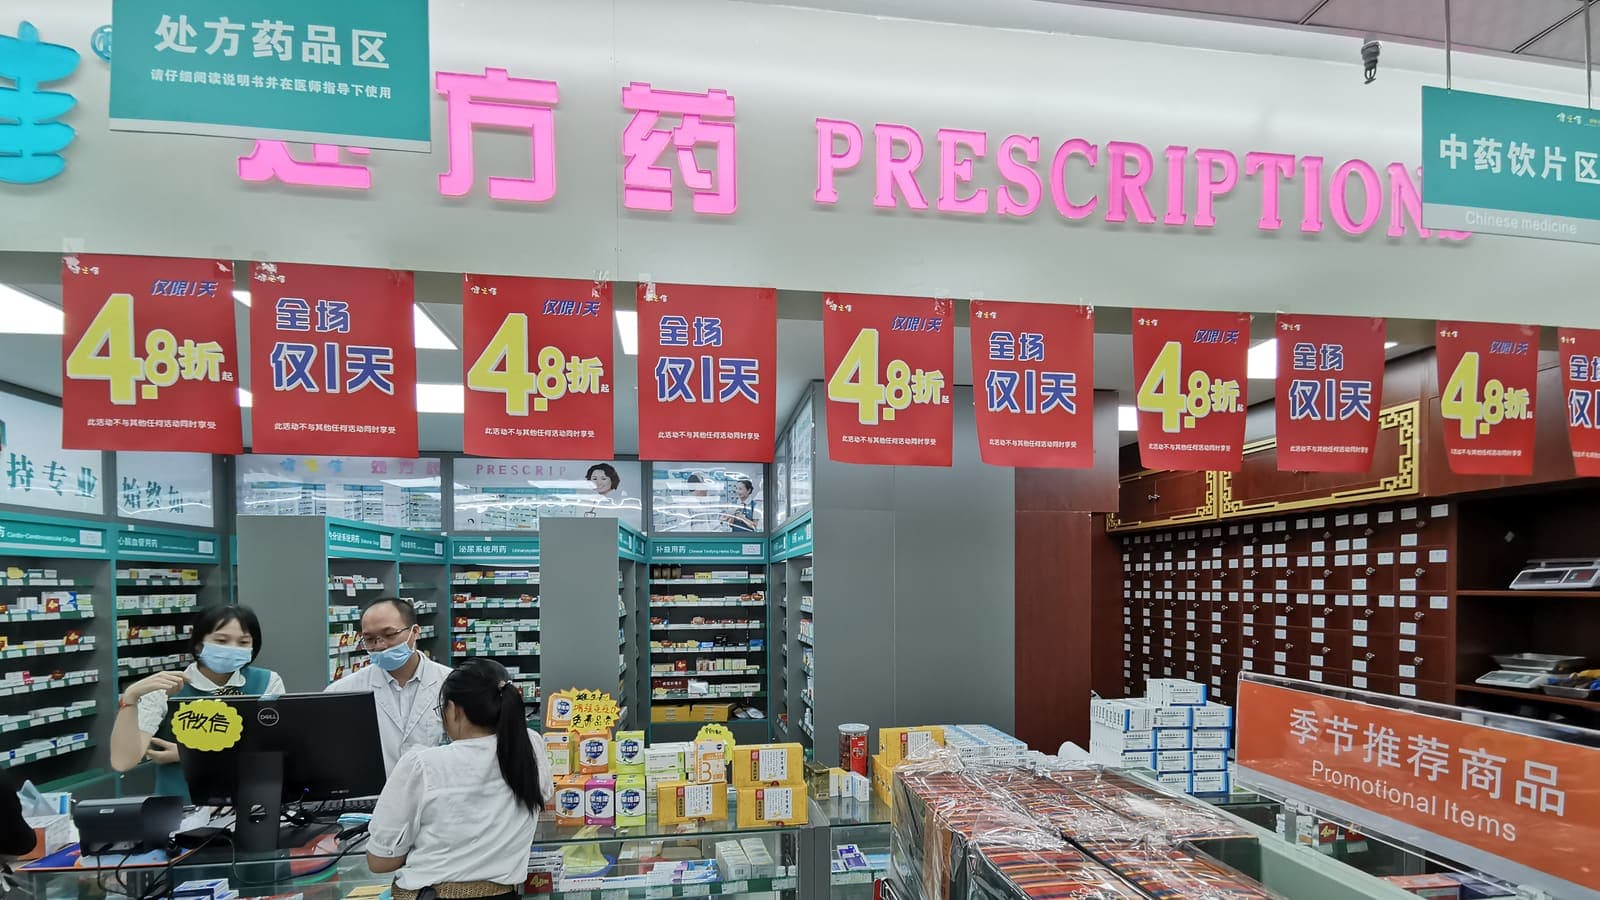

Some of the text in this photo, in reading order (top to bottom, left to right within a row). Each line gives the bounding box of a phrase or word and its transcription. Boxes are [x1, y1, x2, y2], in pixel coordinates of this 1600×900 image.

[154, 14, 390, 69] 处方药品区
[150, 69, 392, 100] 请仔细阅读说明书并在医师指导下使用
[237, 67, 737, 215] 方药
[813, 117, 1472, 241] PRESCRIPTION
[1439, 133, 1600, 185] 中药饮片区
[1465, 210, 1577, 235] Chinese medicine
[151, 279, 219, 298] 仅限1天
[276, 297, 350, 334] 全场
[541, 299, 601, 317] 仅限1天
[891, 315, 943, 333] 仅限1天
[660, 315, 723, 347] 全场
[988, 331, 1045, 362] 全场
[270, 341, 395, 395] 仅1天
[1293, 342, 1344, 372] 全场
[655, 355, 760, 405] 仅1天
[985, 369, 1077, 415] 仅1天
[1288, 378, 1372, 422] 仅1天
[476, 463, 567, 477] PRESCRIP
[655, 545, 687, 554] 补益用药
[177, 709, 231, 735] 微信
[1289, 708, 1566, 817] 季节推荐商品
[1311, 760, 1517, 842] Promotional Items
